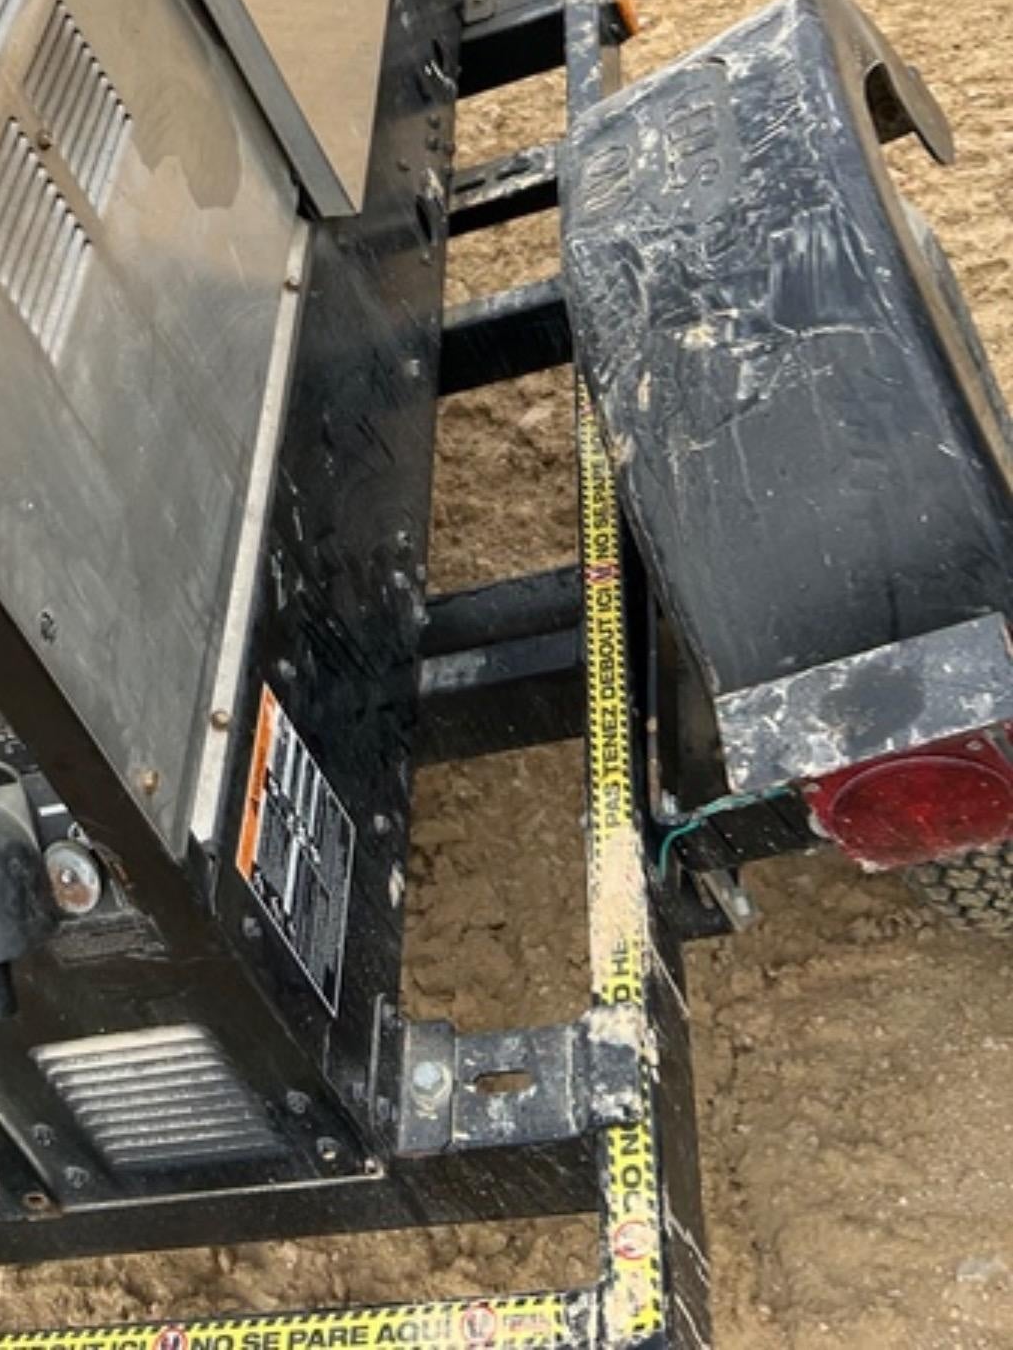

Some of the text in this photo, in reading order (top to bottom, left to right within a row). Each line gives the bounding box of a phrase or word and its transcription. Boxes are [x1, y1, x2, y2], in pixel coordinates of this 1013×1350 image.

[593, 533, 609, 559] NO
[596, 587, 612, 613] ICI
[595, 617, 616, 701] DEBOUT
[600, 705, 618, 777] TENEZ
[191, 1335, 234, 1350] NO
[242, 1332, 281, 1350] SE
[288, 1324, 369, 1349] PARE
